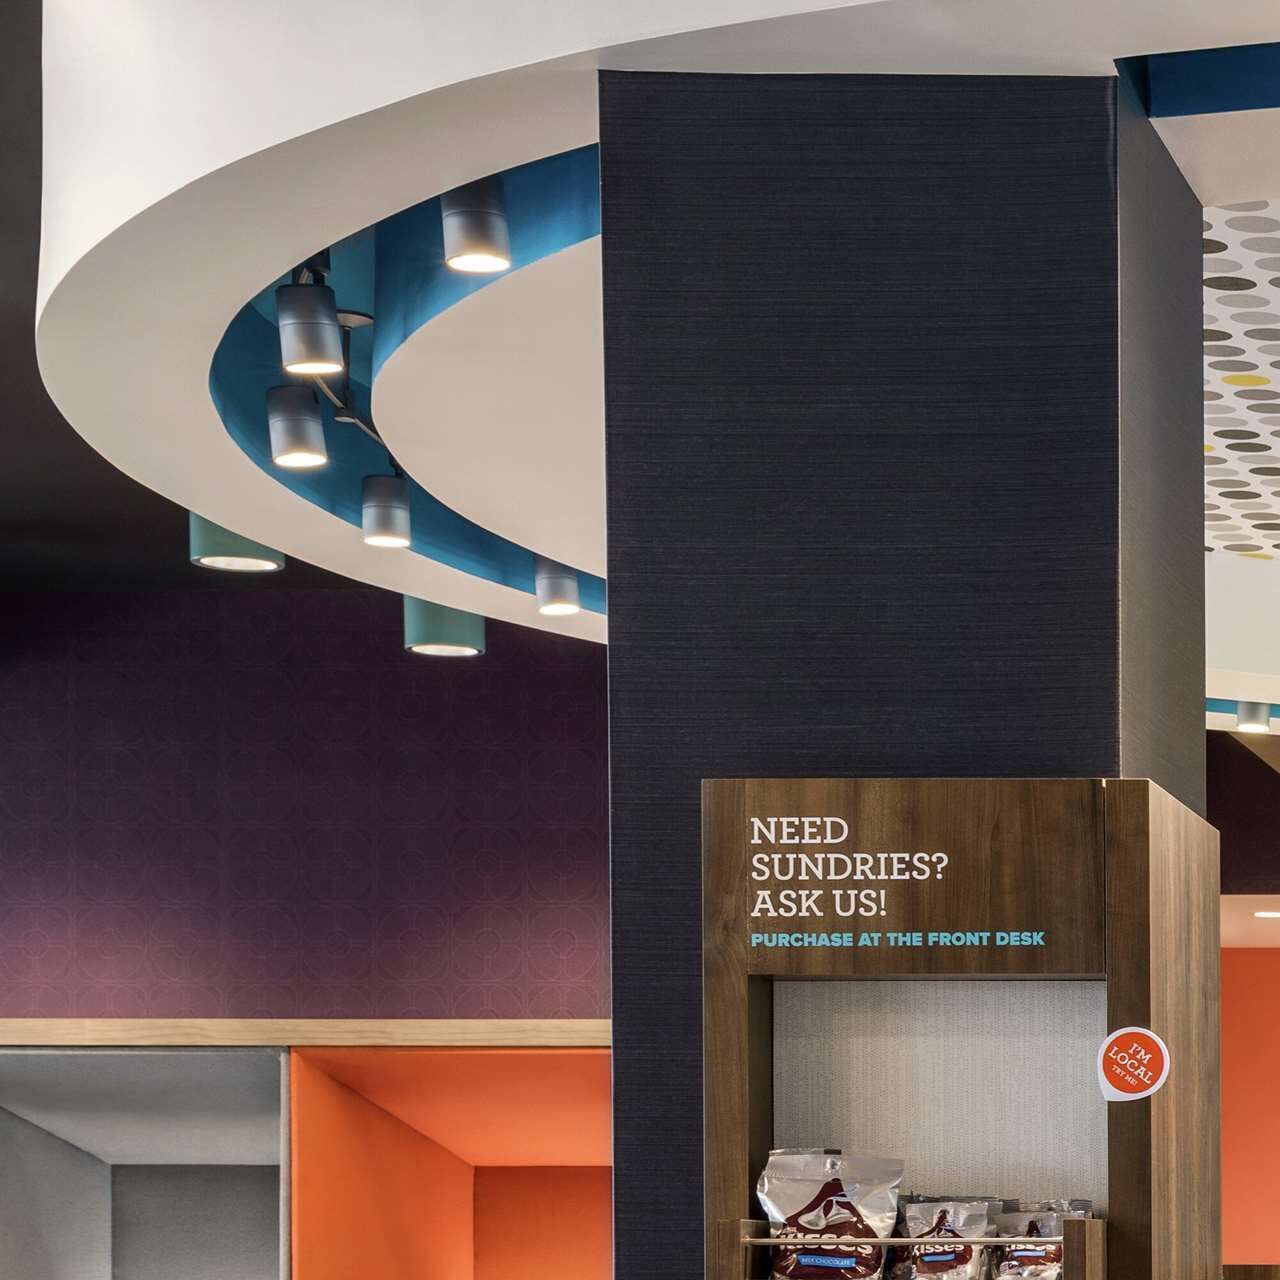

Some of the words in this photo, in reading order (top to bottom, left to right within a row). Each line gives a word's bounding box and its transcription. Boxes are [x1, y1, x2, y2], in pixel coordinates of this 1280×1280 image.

[750, 817, 849, 845] NEED
[750, 852, 949, 881] SUNDRIES?
[750, 889, 824, 917] ASK
[834, 889, 887, 917] US!
[751, 932, 854, 948] PURCHASE
[857, 932, 882, 947] AT
[886, 932, 923, 947] THE
[928, 932, 990, 947] FRONT
[995, 931, 1046, 946] DESK
[1108, 1046, 1153, 1084] LOCAL
[1128, 1042, 1152, 1064] I'M
